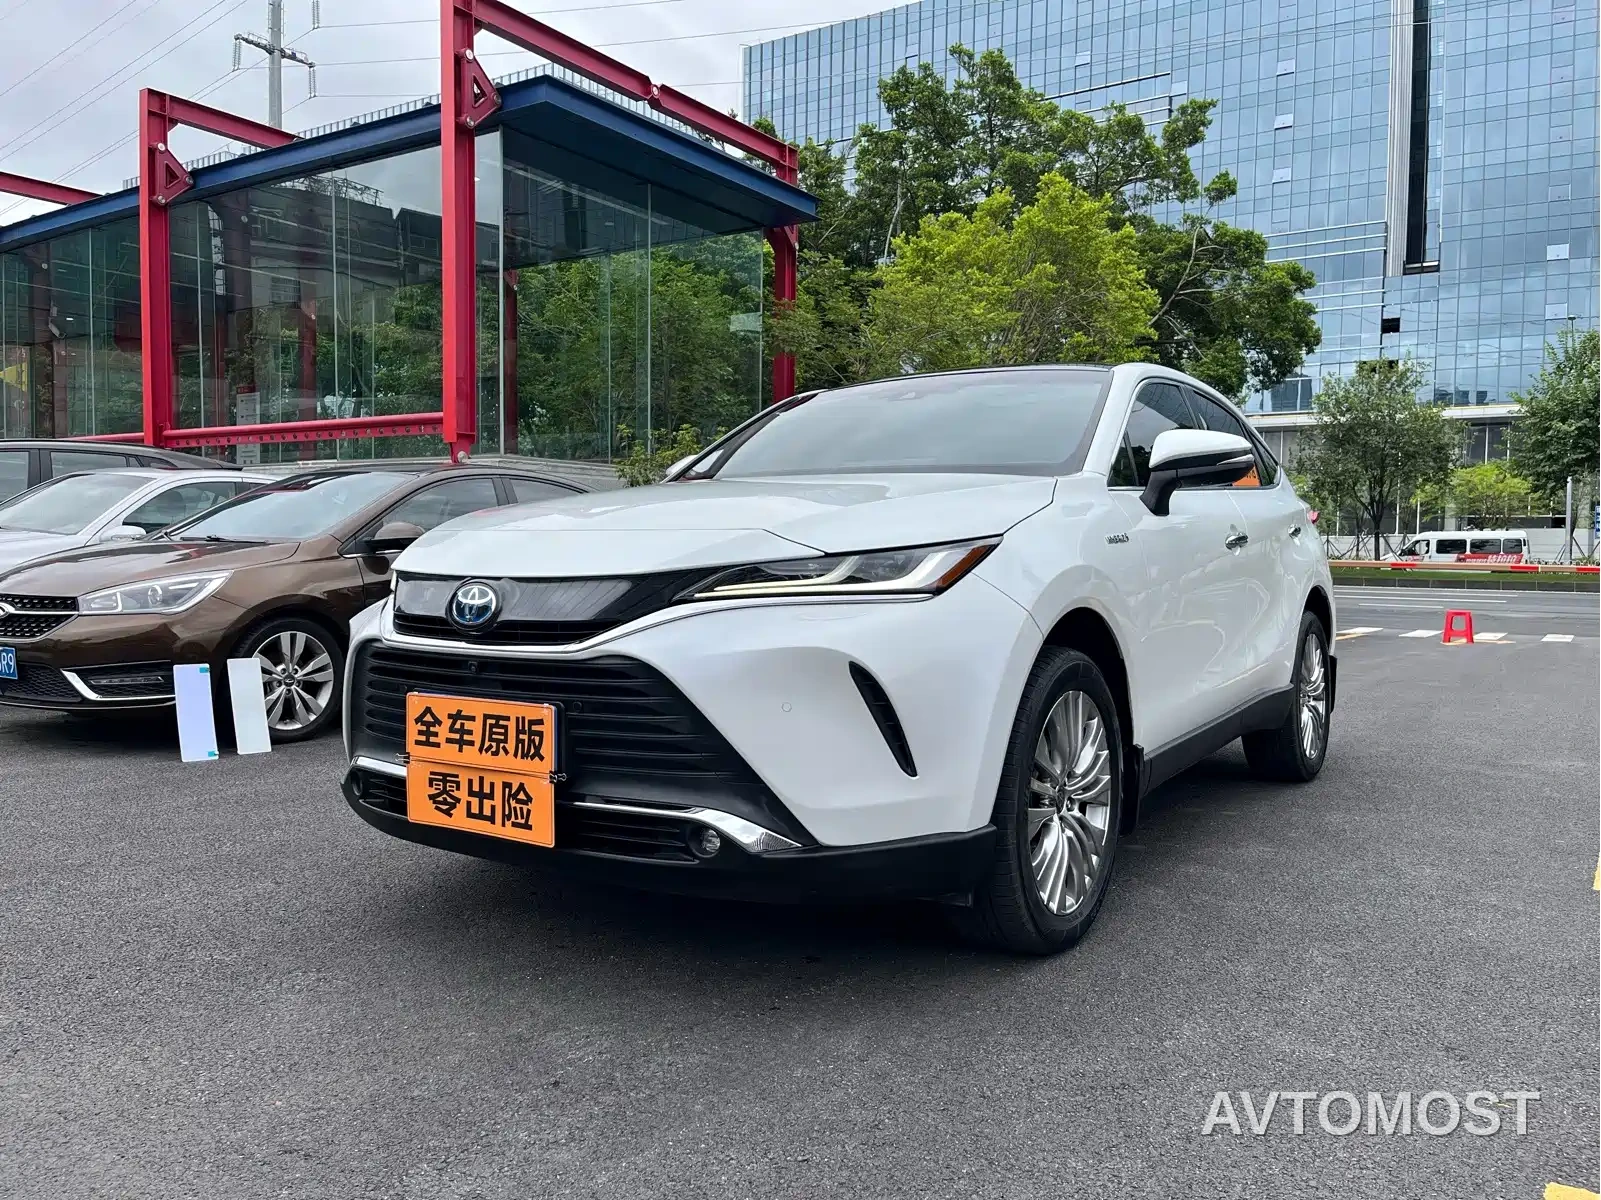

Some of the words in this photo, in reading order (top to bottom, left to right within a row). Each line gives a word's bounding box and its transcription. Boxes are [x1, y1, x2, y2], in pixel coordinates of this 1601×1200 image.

[0, 652, 14, 674] R9
[414, 706, 545, 762] 全车原版
[428, 771, 533, 831] 零出险
